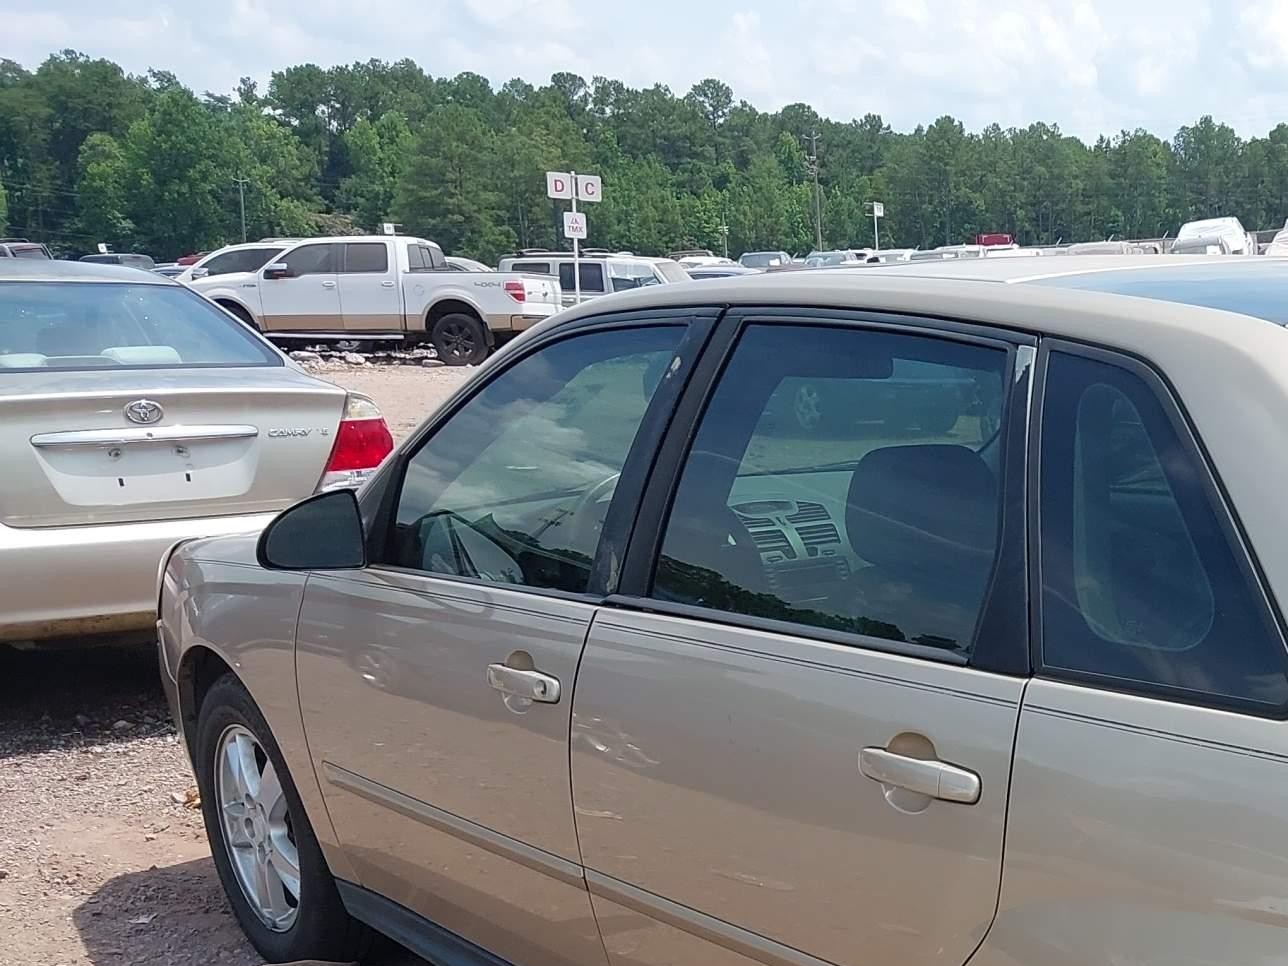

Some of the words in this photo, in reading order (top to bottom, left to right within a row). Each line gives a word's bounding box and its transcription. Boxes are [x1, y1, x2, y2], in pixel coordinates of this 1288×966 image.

[554, 179, 565, 193] D
[585, 182, 595, 196] C
[268, 427, 313, 438] CAMRY
